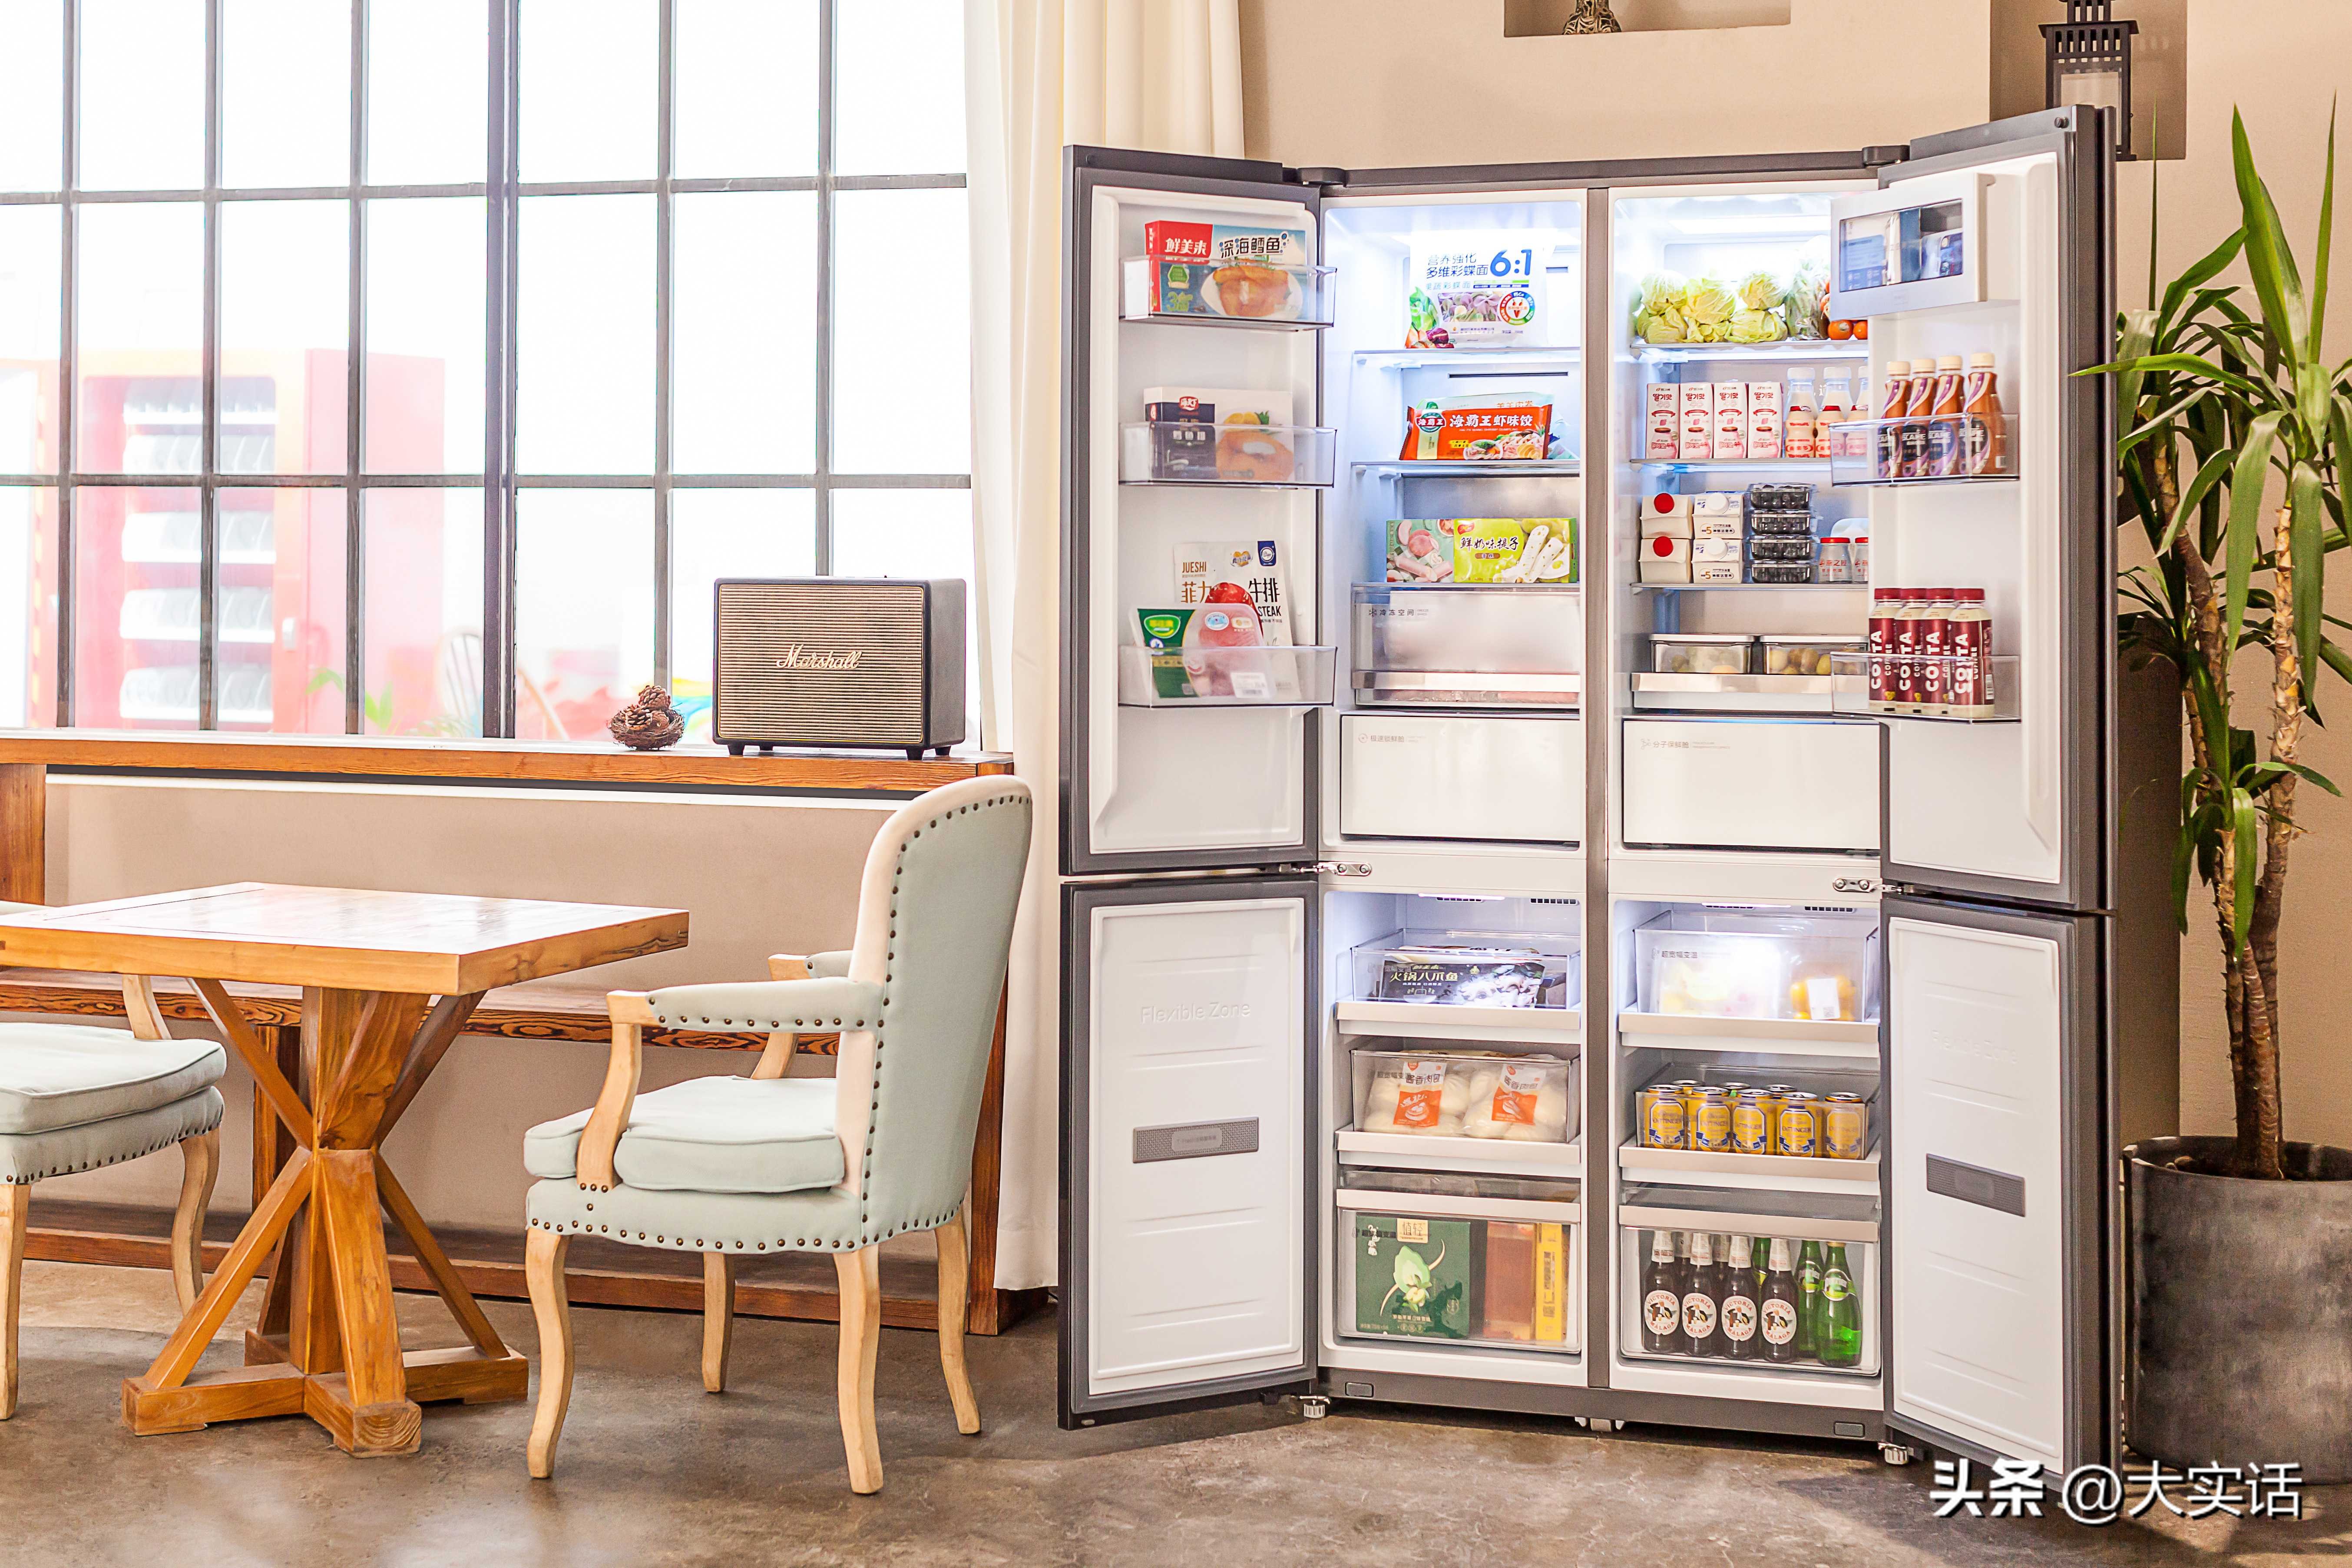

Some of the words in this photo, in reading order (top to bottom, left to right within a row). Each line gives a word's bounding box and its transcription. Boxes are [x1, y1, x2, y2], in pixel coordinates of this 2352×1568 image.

[1221, 237, 1280, 258] 深海鳕鱼
[1490, 249, 1532, 277] 6:1
[1449, 414, 1533, 428] 海霸王虾味饺
[1460, 536, 1519, 551] 鲜奶味提子
[1182, 561, 1207, 573] JUESHI
[1181, 580, 1212, 603] 菲力
[1248, 577, 1280, 603] 牛排
[1258, 605, 1281, 617] STEAK
[775, 643, 863, 670] Marshall
[1884, 644, 1892, 676] COEE
[1389, 972, 1458, 982] 火锅八爪鱼
[1140, 1002, 1204, 1024] Flexible
[1208, 1001, 1251, 1018] Zone
[1406, 1073, 1440, 1085] 酱香肉包
[1647, 1294, 1676, 1306] VICTORIA
[1684, 1297, 1711, 1309] VICTORIA
[1725, 1300, 1752, 1311] VICTORIA
[1763, 1303, 1791, 1315] VICTORIA
